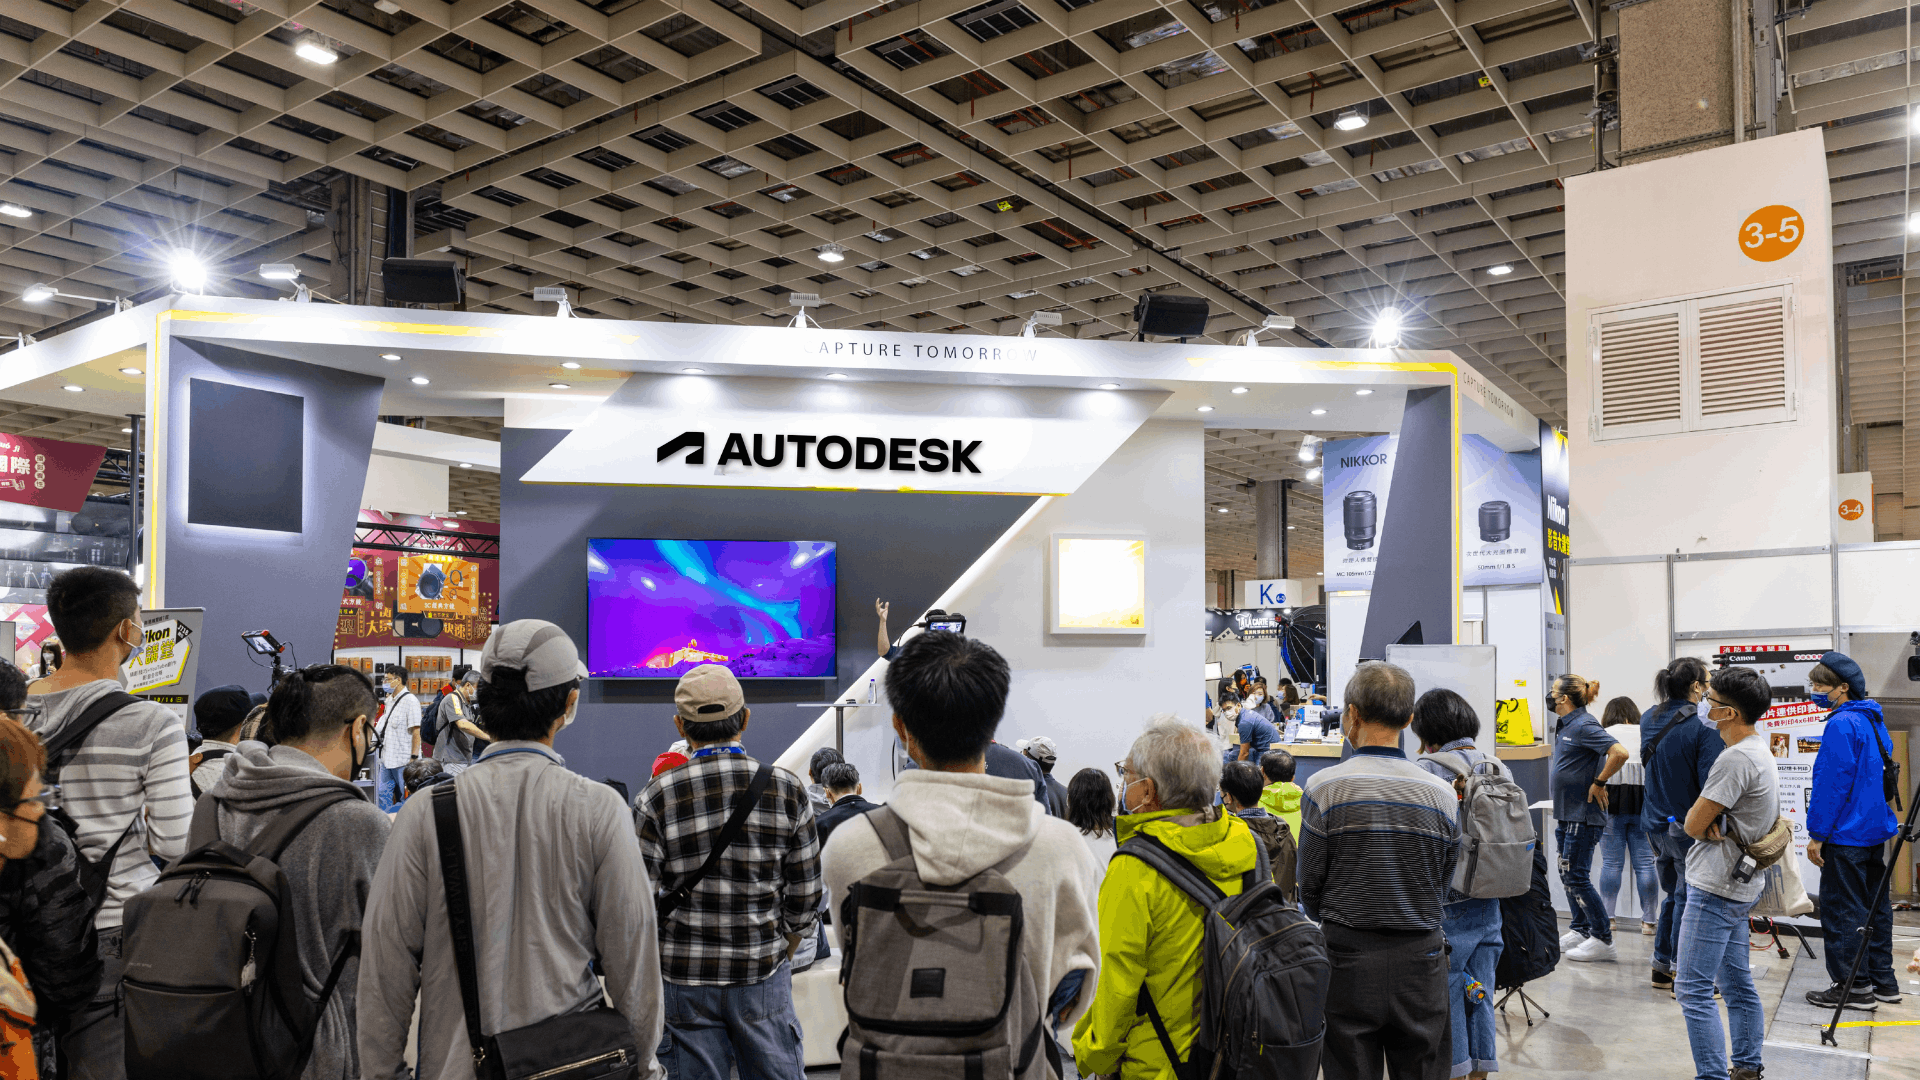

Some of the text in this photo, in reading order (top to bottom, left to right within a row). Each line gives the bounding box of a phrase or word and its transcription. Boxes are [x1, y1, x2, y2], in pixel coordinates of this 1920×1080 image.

[1744, 216, 1799, 248] 3-5
[804, 341, 1037, 361] CAPTURE TOMORROW
[717, 432, 983, 474] AUTODESK
[1340, 453, 1388, 469] NIKKOR
[1547, 494, 1566, 527] Nikon
[1840, 504, 1862, 516] 3-4
[1260, 583, 1275, 605] K
